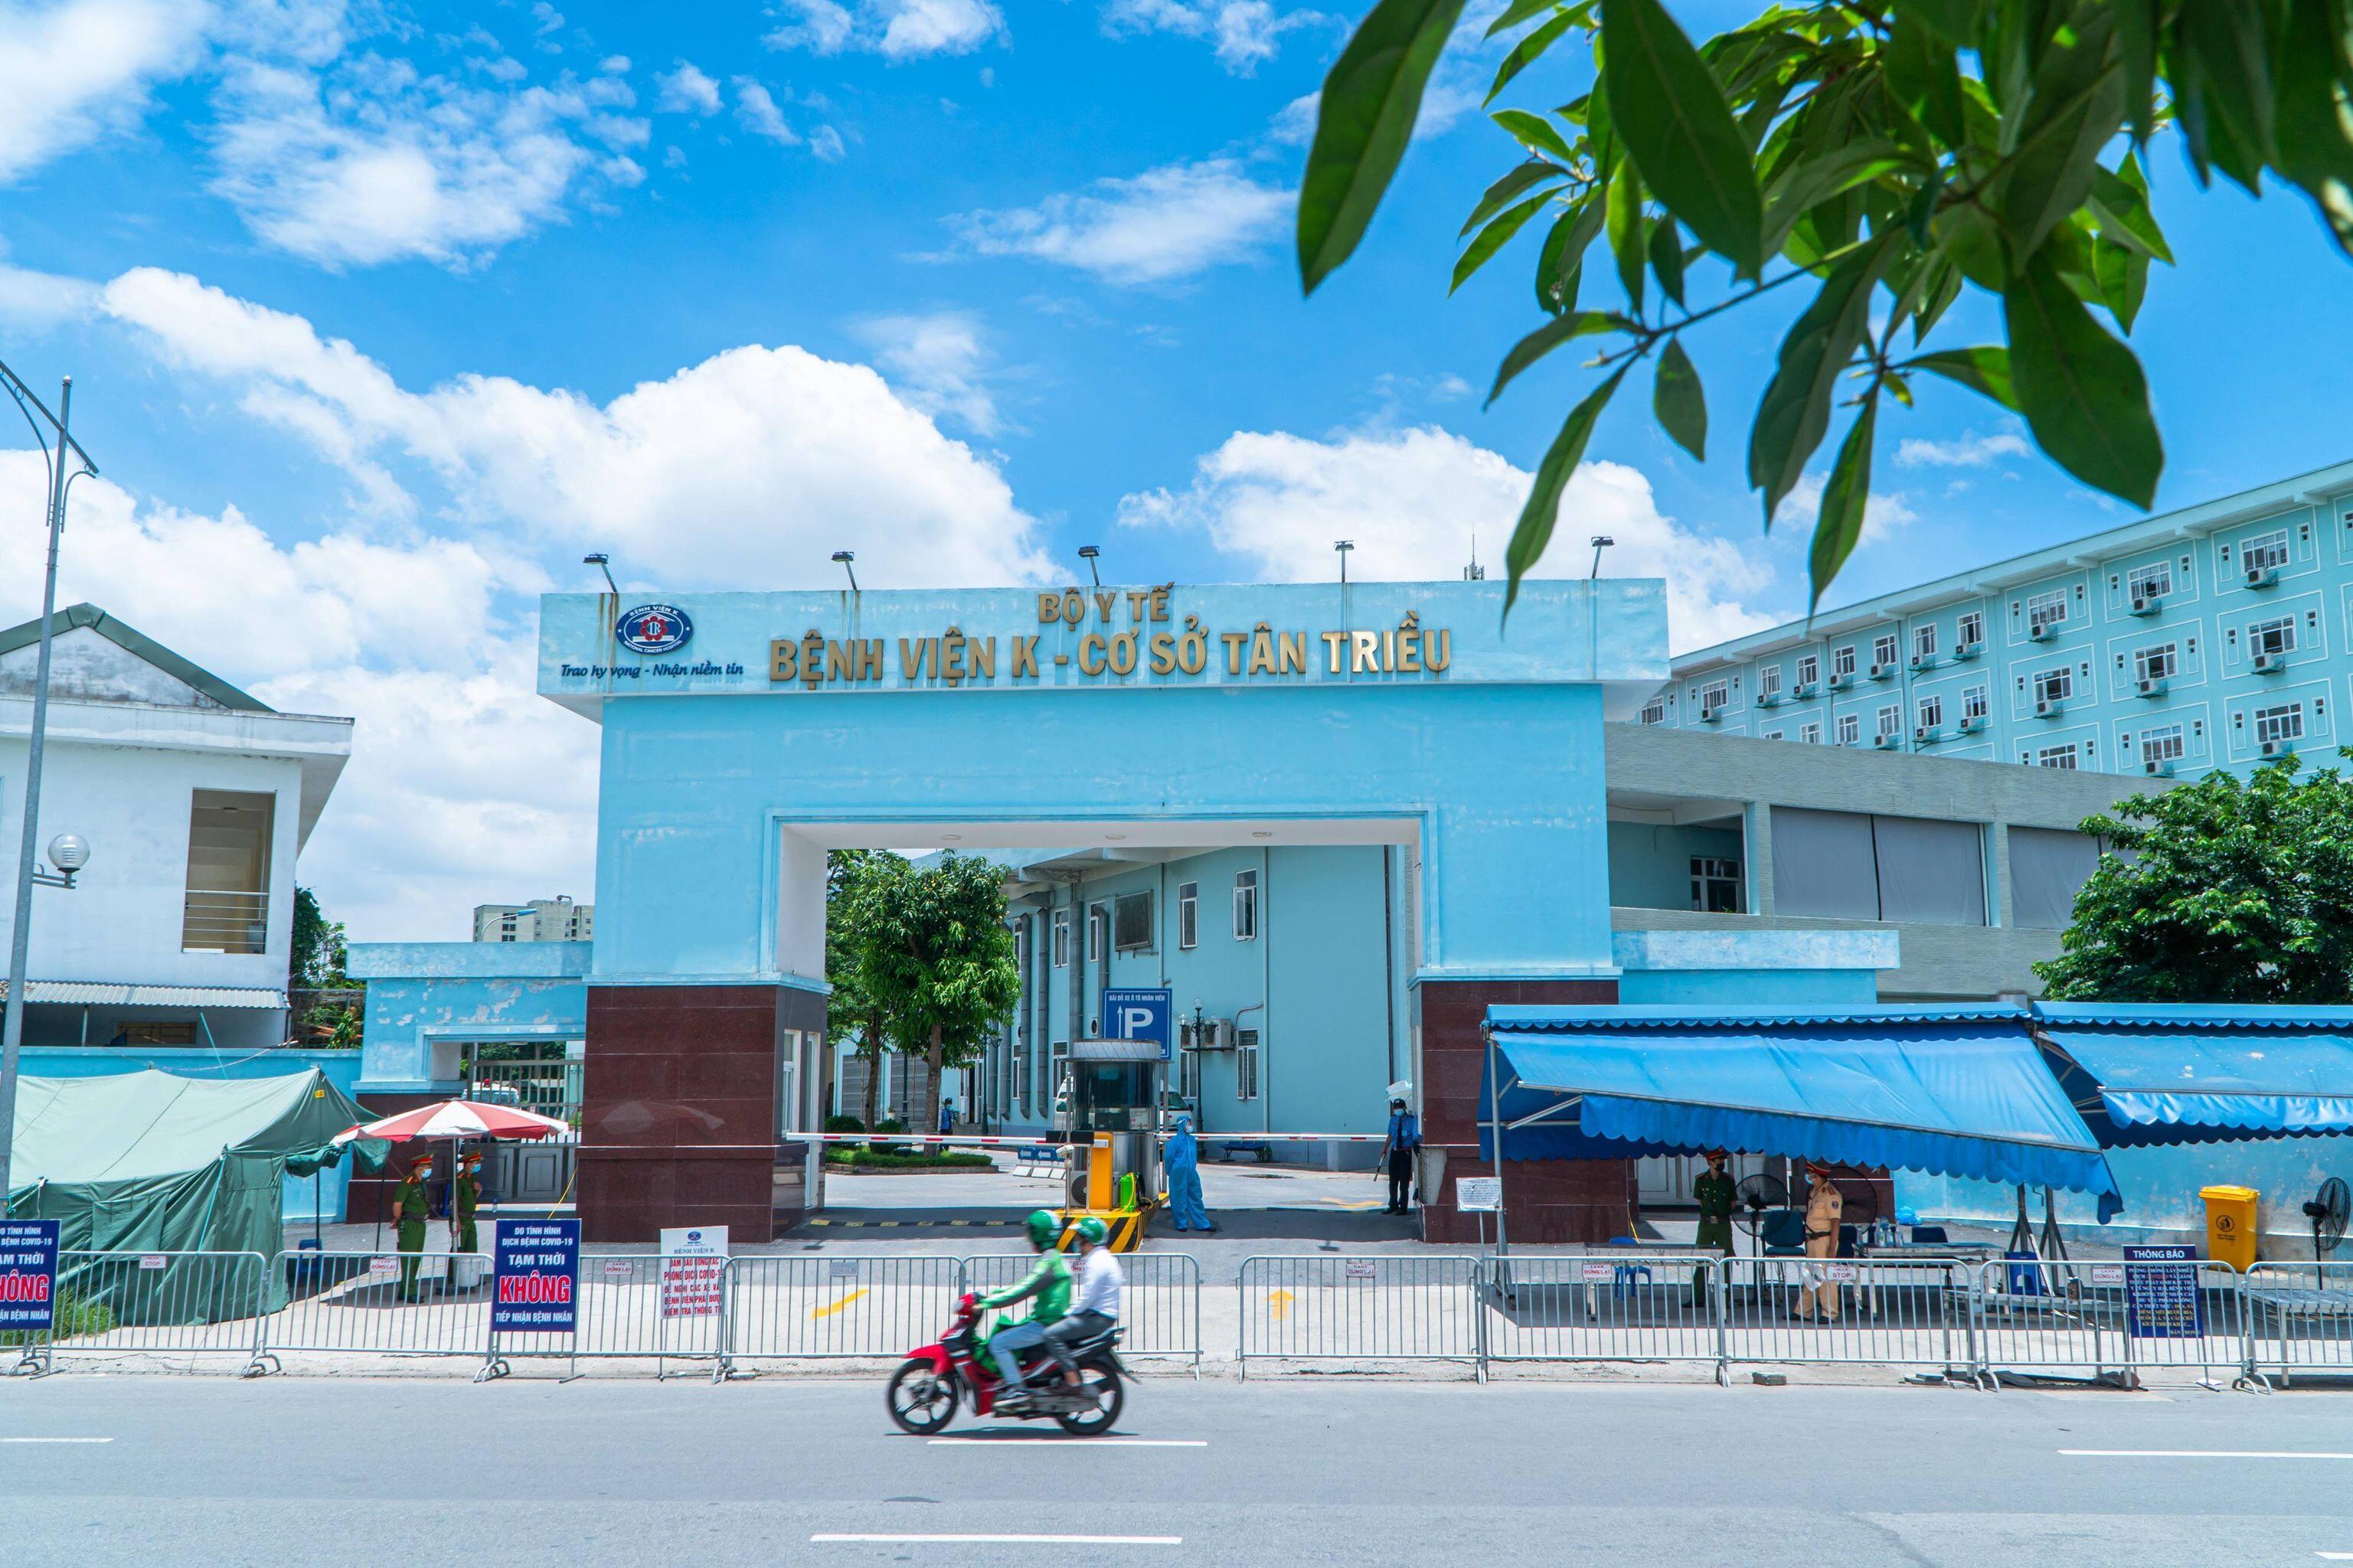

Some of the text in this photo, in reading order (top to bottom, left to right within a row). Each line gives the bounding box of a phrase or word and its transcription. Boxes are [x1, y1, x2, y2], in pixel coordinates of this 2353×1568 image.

[1039, 582, 1175, 631] BỘ Y TẾ
[770, 630, 883, 689] BỆNH
[899, 627, 995, 687] VIỆN
[1013, 635, 1039, 678] K
[1078, 628, 1139, 676] CƠ
[1149, 616, 1209, 675] SỞ
[1221, 622, 1306, 675] TÂN
[1322, 611, 1450, 673] TRIỀU
[561, 664, 588, 677] Trao
[591, 664, 607, 679] hy
[610, 666, 641, 679] vọng
[653, 663, 688, 679] Nhận
[691, 661, 723, 675] niềm
[726, 662, 743, 675] tin
[1125, 1008, 1153, 1038] P
[526, 1226, 542, 1235] TÌNH
[544, 1226, 561, 1235] HÌNH
[502, 1238, 519, 1247] DỊCH
[521, 1237, 540, 1247] BỆNH
[508, 1255, 534, 1268] TẠM
[2133, 1249, 2185, 1259] THÔNG BÁO
[499, 1269, 571, 1303] KHÔNG
[495, 1310, 572, 1325] TIẾP NHẬN BỆNH NHÂN
